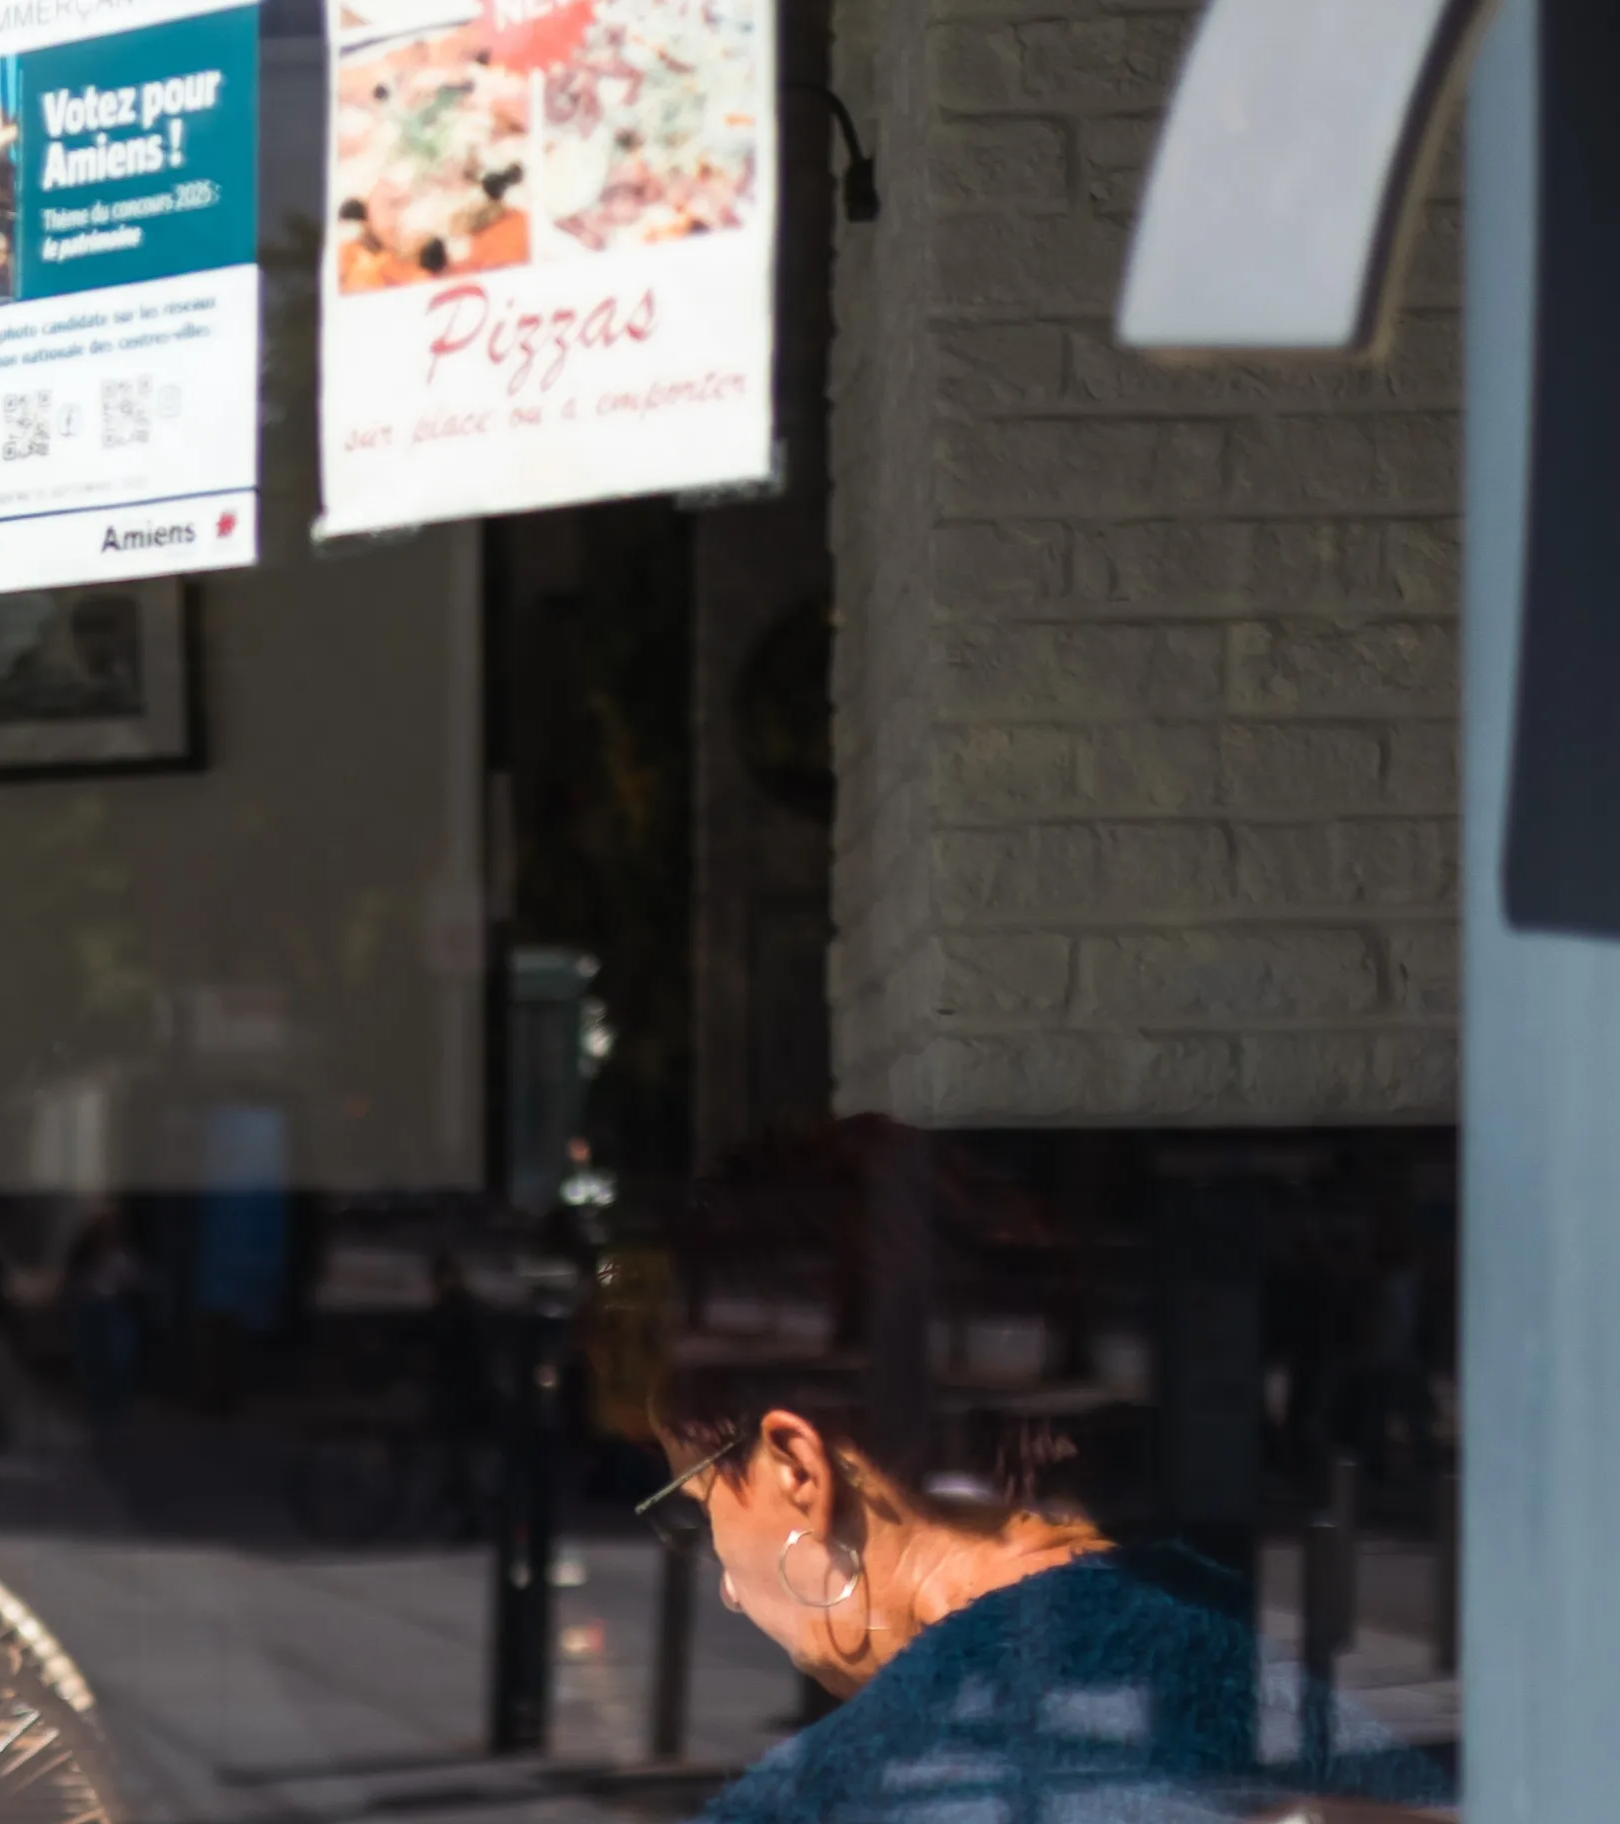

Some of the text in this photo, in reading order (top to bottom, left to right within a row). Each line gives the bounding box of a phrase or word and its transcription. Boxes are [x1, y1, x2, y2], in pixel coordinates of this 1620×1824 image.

[43, 70, 223, 137] Votez pour
[42, 118, 183, 191] Amiens !
[0, 326, 38, 345] photo
[42, 315, 108, 338] candidate
[114, 311, 134, 325] sur
[426, 281, 658, 396] Pizzas
[22, 345, 84, 366] nationale
[90, 339, 114, 355] des
[410, 410, 490, 453] place
[510, 406, 542, 428] ou
[100, 518, 196, 555] Amiens
